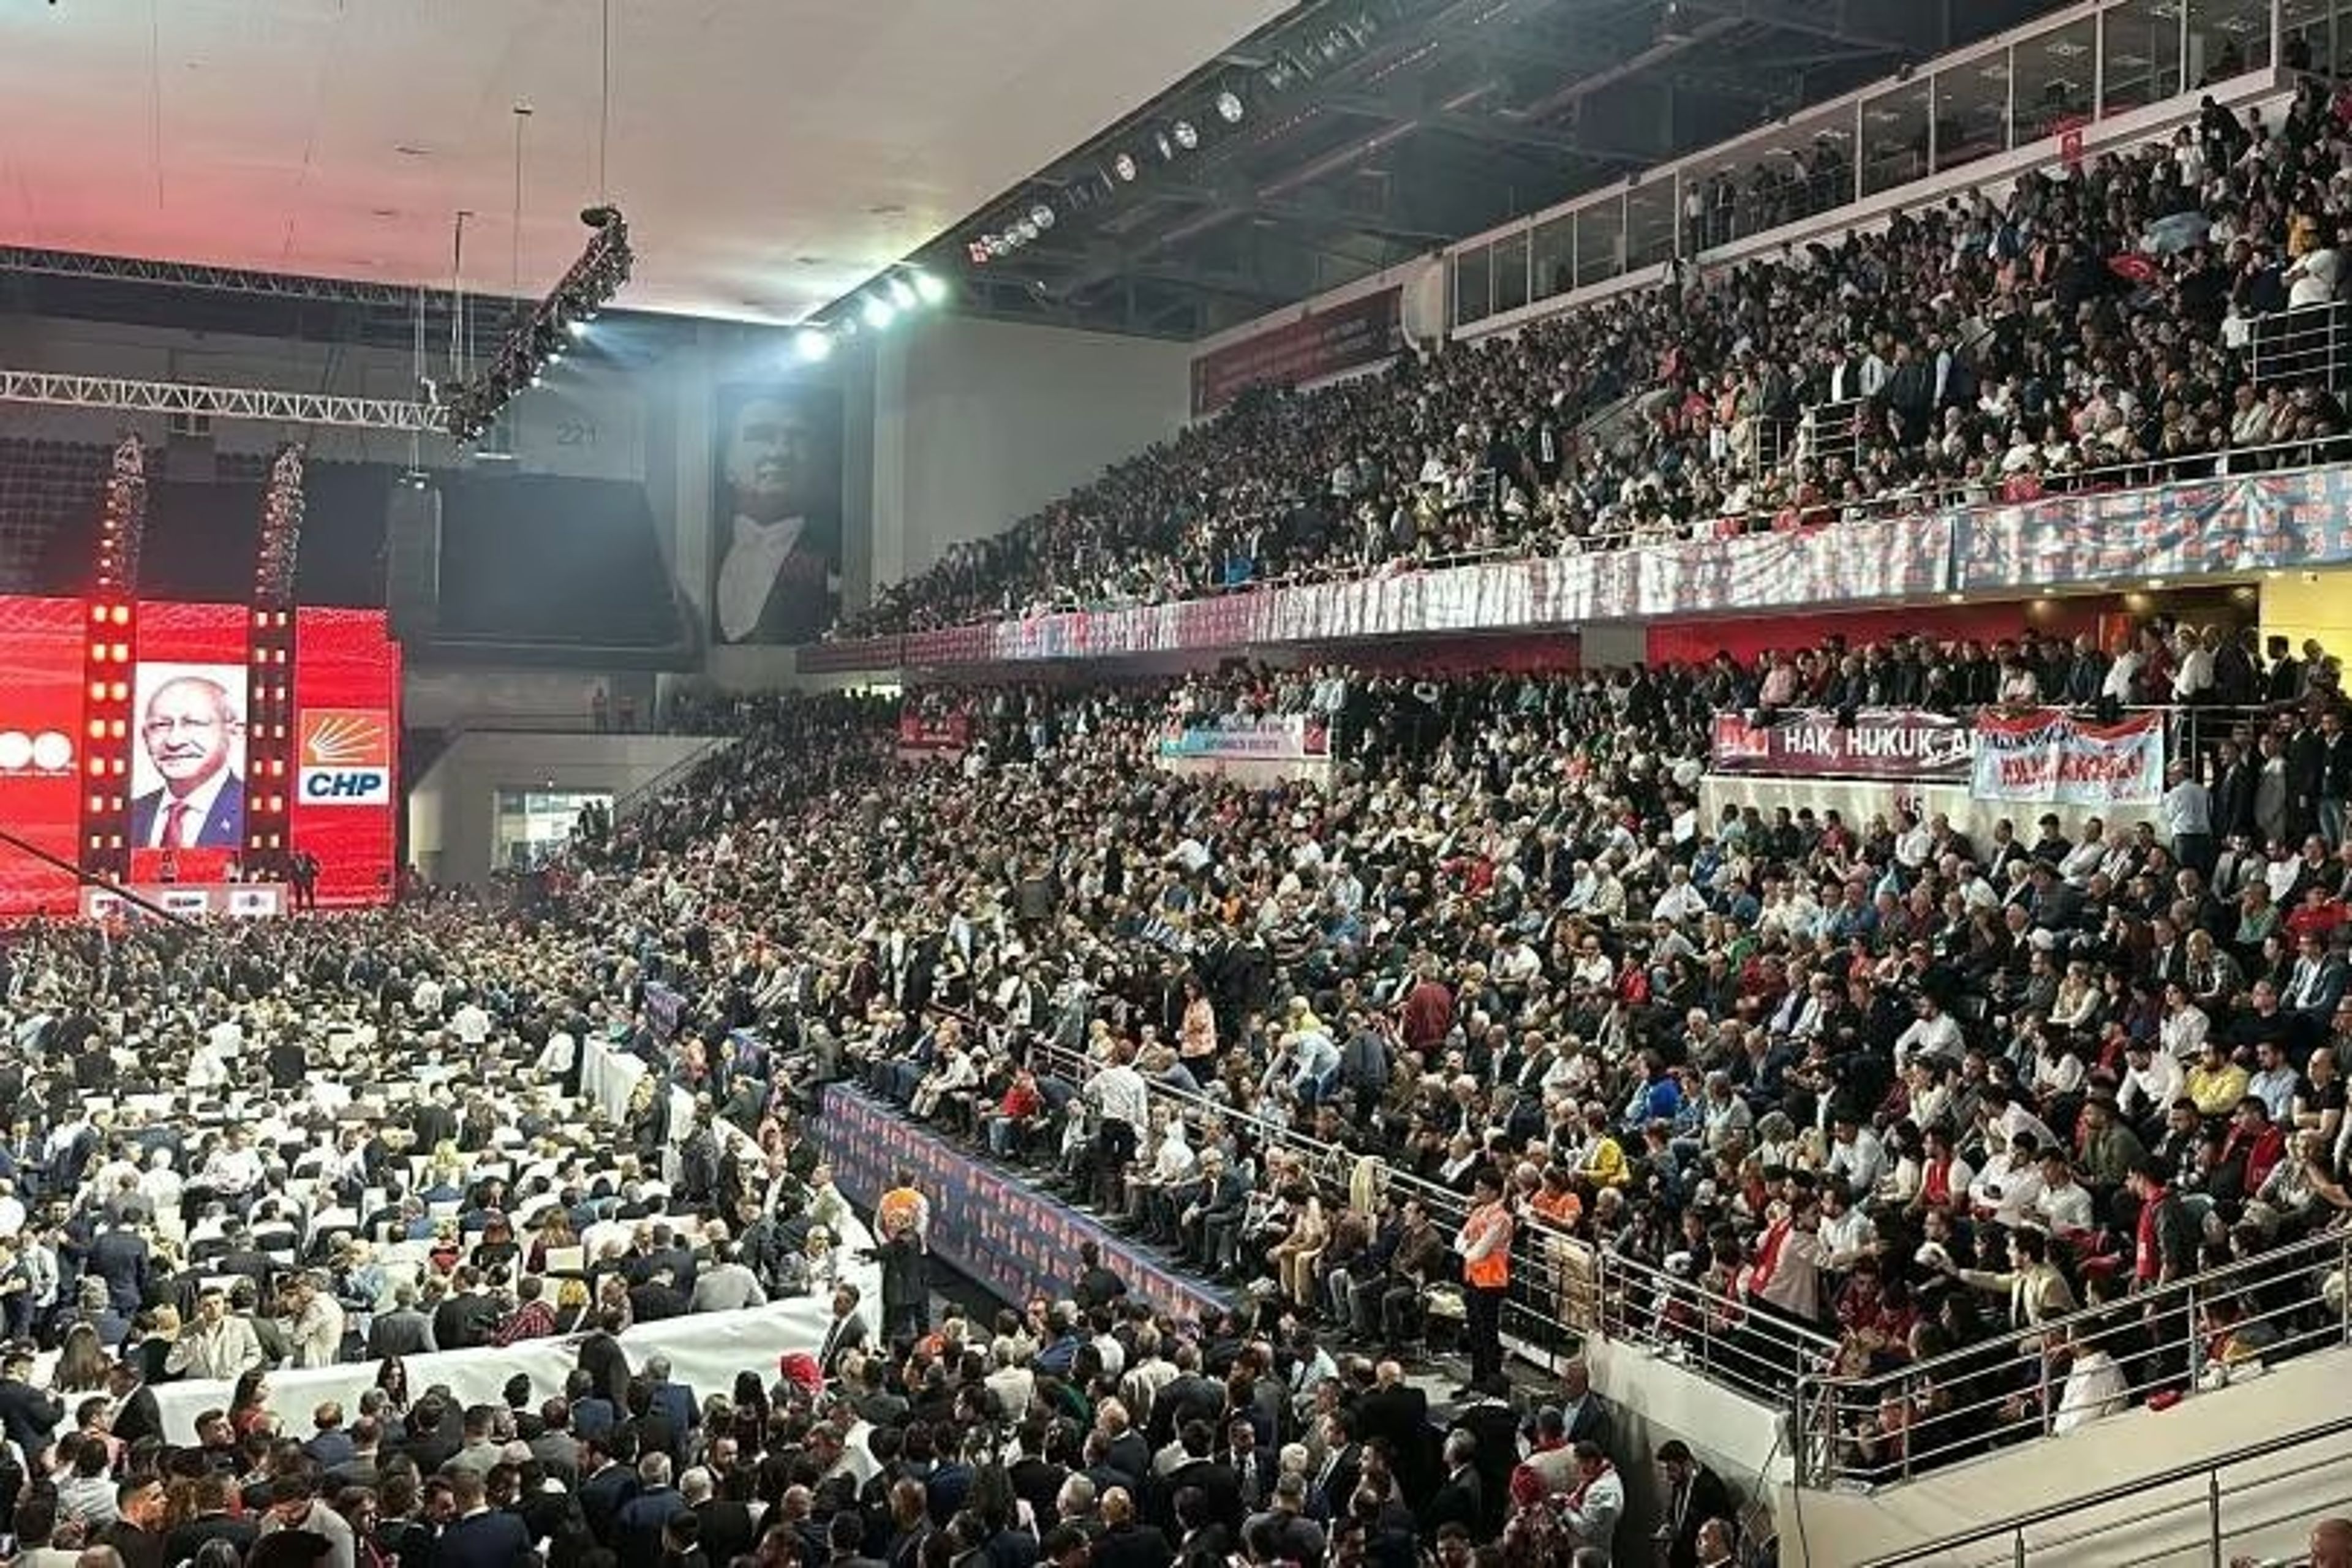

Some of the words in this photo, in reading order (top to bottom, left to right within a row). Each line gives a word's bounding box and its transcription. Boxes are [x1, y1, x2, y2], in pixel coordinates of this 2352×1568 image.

[1784, 728, 1838, 761] HAK,
[1845, 728, 1942, 758] HUKUK,
[307, 772, 382, 797] CHP
